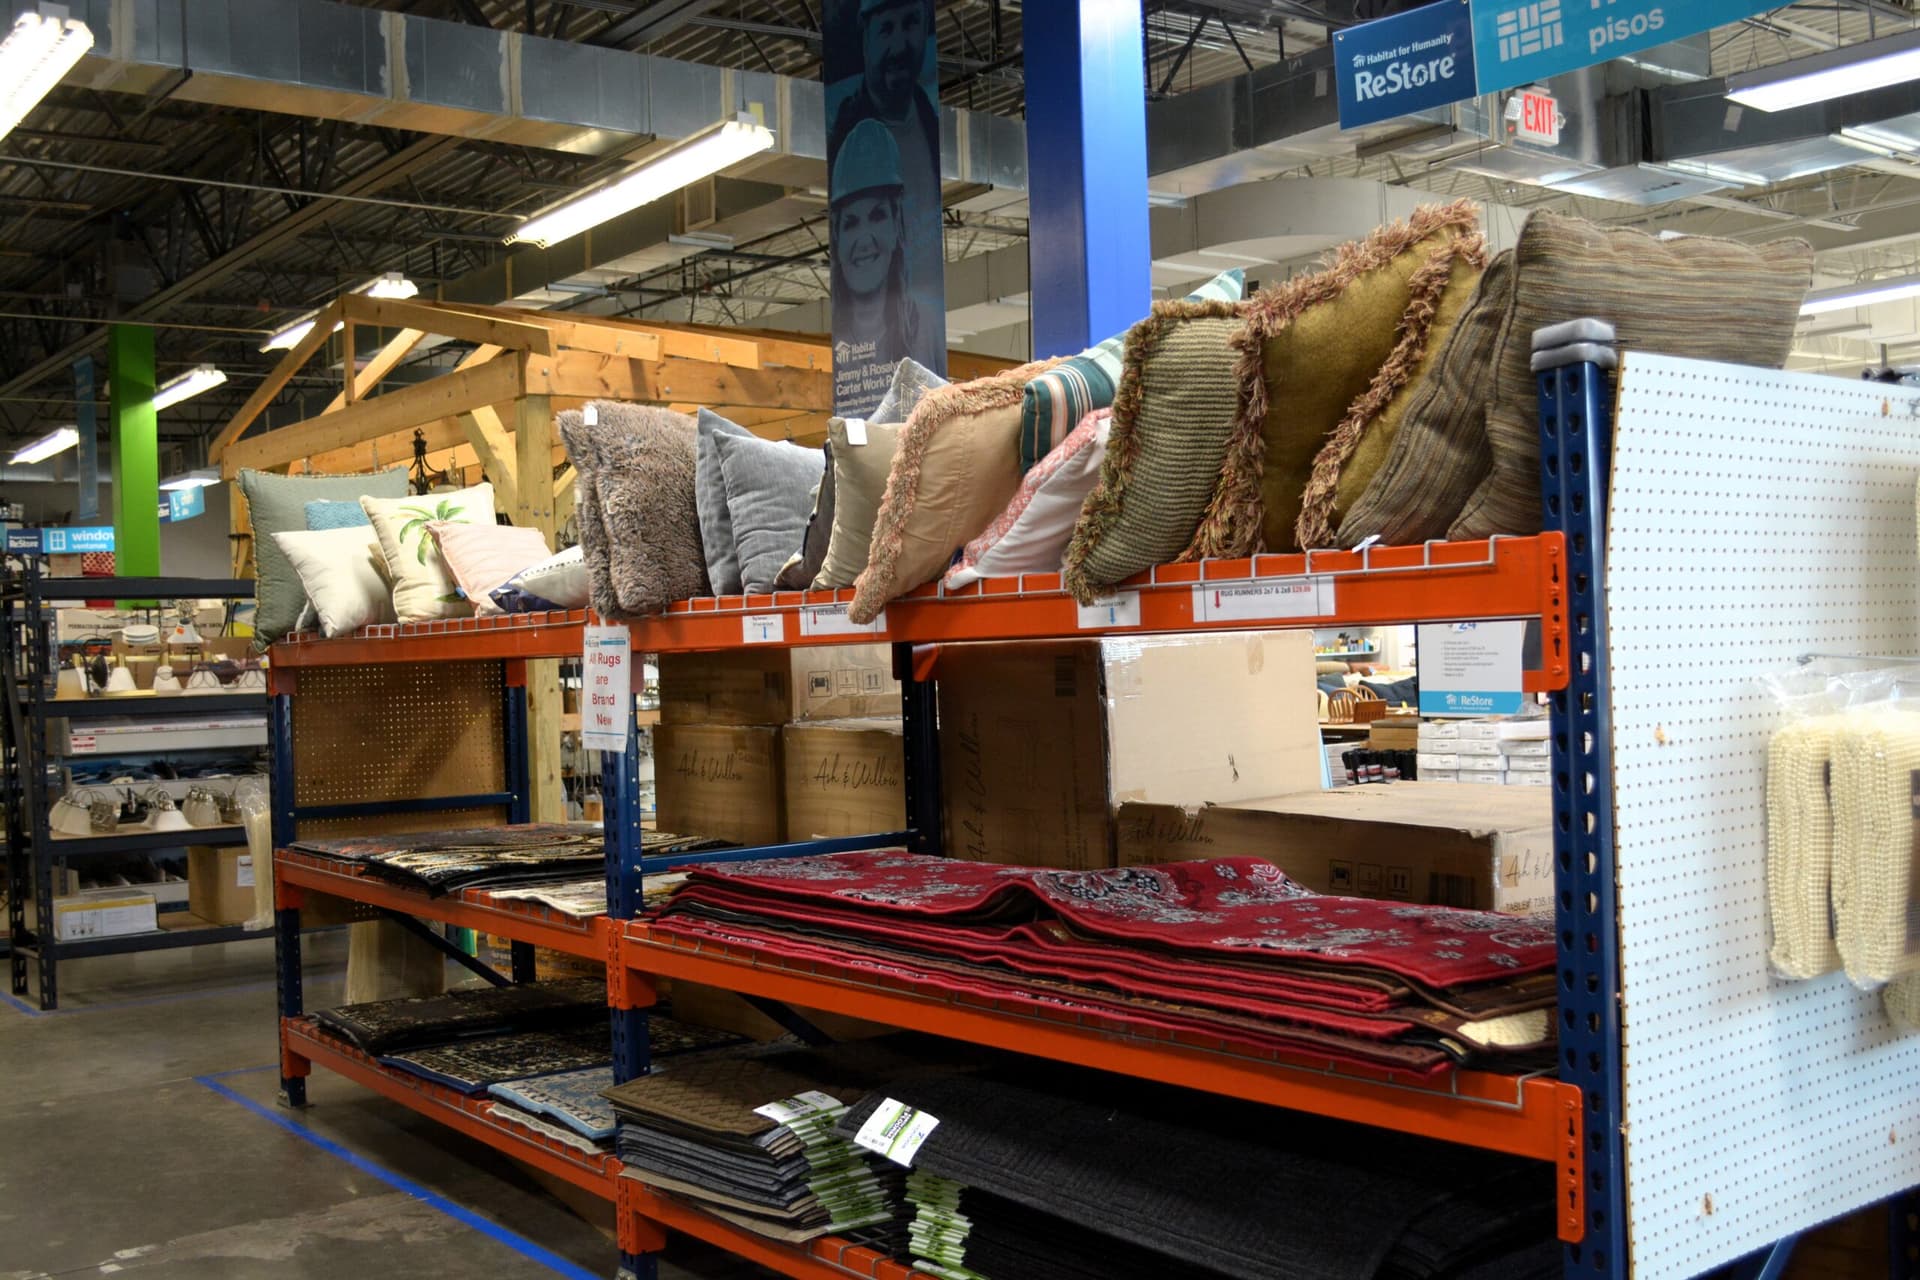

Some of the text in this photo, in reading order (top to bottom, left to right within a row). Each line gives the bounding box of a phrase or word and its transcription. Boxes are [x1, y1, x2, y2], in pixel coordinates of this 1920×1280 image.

[1589, 7, 1664, 55] pisos
[1367, 33, 1451, 65] Habitat for Humanity
[1355, 55, 1455, 101] ReStore
[1523, 93, 1554, 135] EXIT
[852, 341, 876, 355] Habitat
[836, 368, 861, 383] Jimmy
[862, 366, 869, 376] &
[836, 383, 862, 396] Carter
[863, 377, 884, 391] Work
[589, 653, 621, 667] All Rugs
[596, 675, 609, 686] are
[592, 694, 615, 706] Brand
[1461, 694, 1494, 706] ReStore
[597, 714, 612, 726] New
[675, 750, 698, 781] Ash
[707, 753, 743, 782] Willow
[814, 752, 839, 791] Ash
[853, 756, 897, 789] Willow
